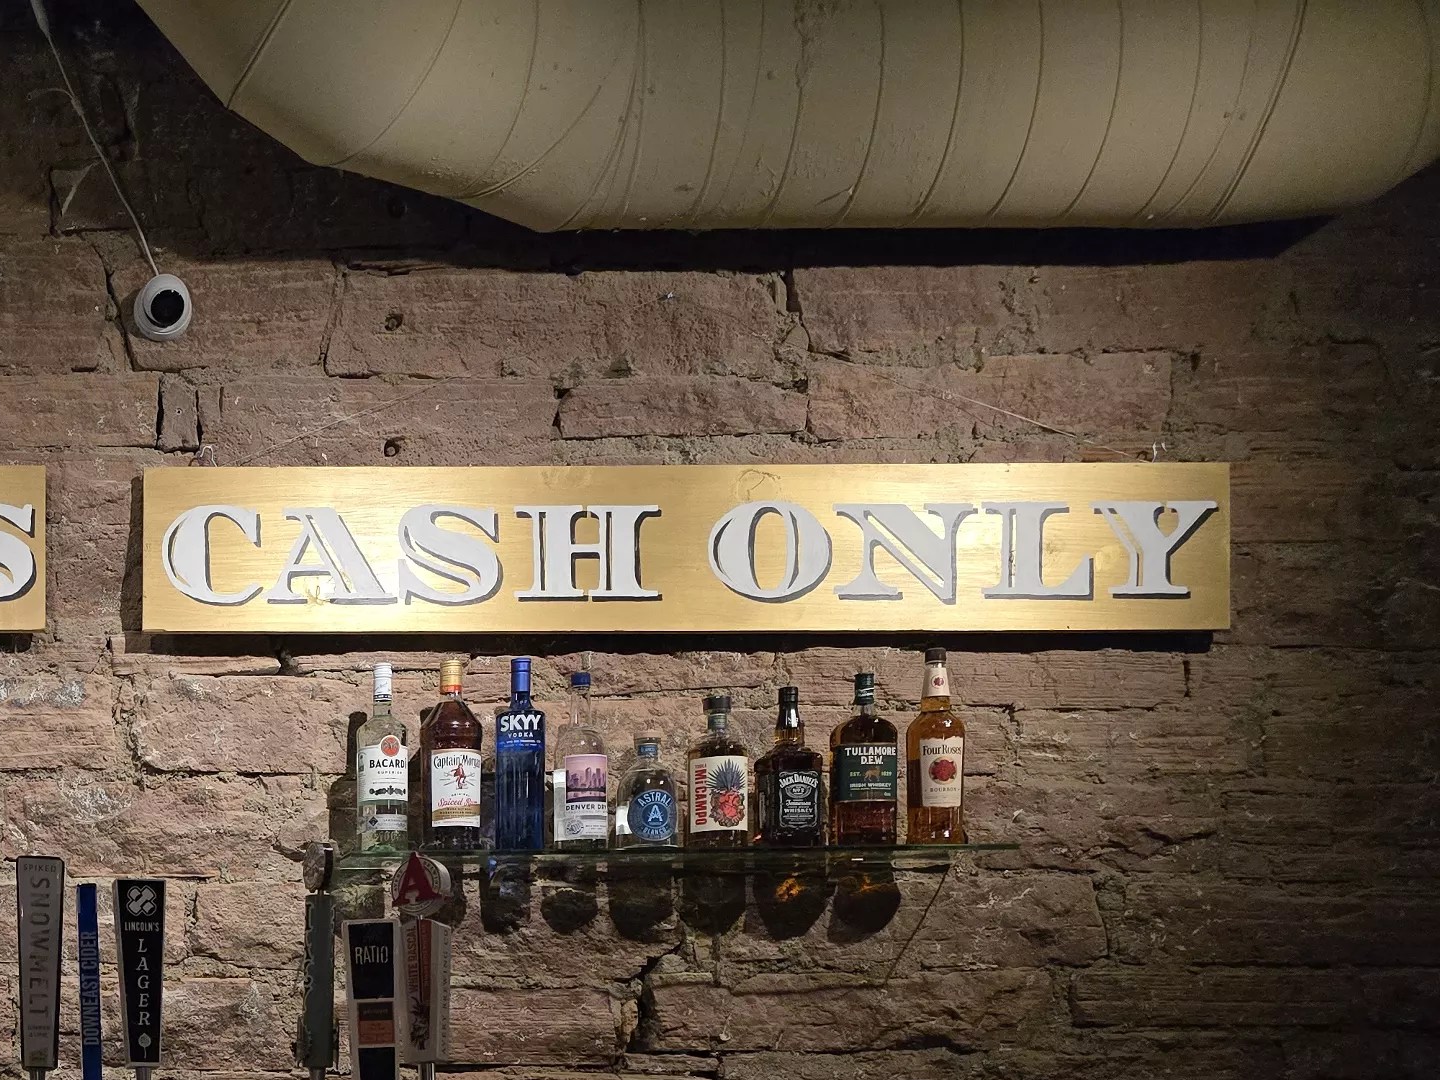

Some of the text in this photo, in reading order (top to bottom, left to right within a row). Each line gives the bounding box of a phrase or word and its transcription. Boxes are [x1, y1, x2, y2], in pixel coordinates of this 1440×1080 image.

[161, 499, 1219, 607] CASH ONLY
[500, 714, 542, 732] SKYY
[844, 746, 897, 756] TULLAMORE
[922, 744, 962, 756] Four Roses
[433, 755, 461, 769] Captain
[860, 756, 884, 765] D.E.W.
[778, 775, 795, 788] JACK
[437, 797, 463, 807] Spiced
[637, 791, 672, 807] ASTRAL
[565, 803, 595, 811] DENVER
[23, 863, 57, 873] SPIKED
[124, 921, 160, 932] LINCOLN'S
[28, 877, 51, 1018] SNOWMELT
[353, 945, 390, 965] RATIO
[80, 930, 100, 1046] DOWNEAST CIDER
[135, 938, 152, 1026] LAGER
